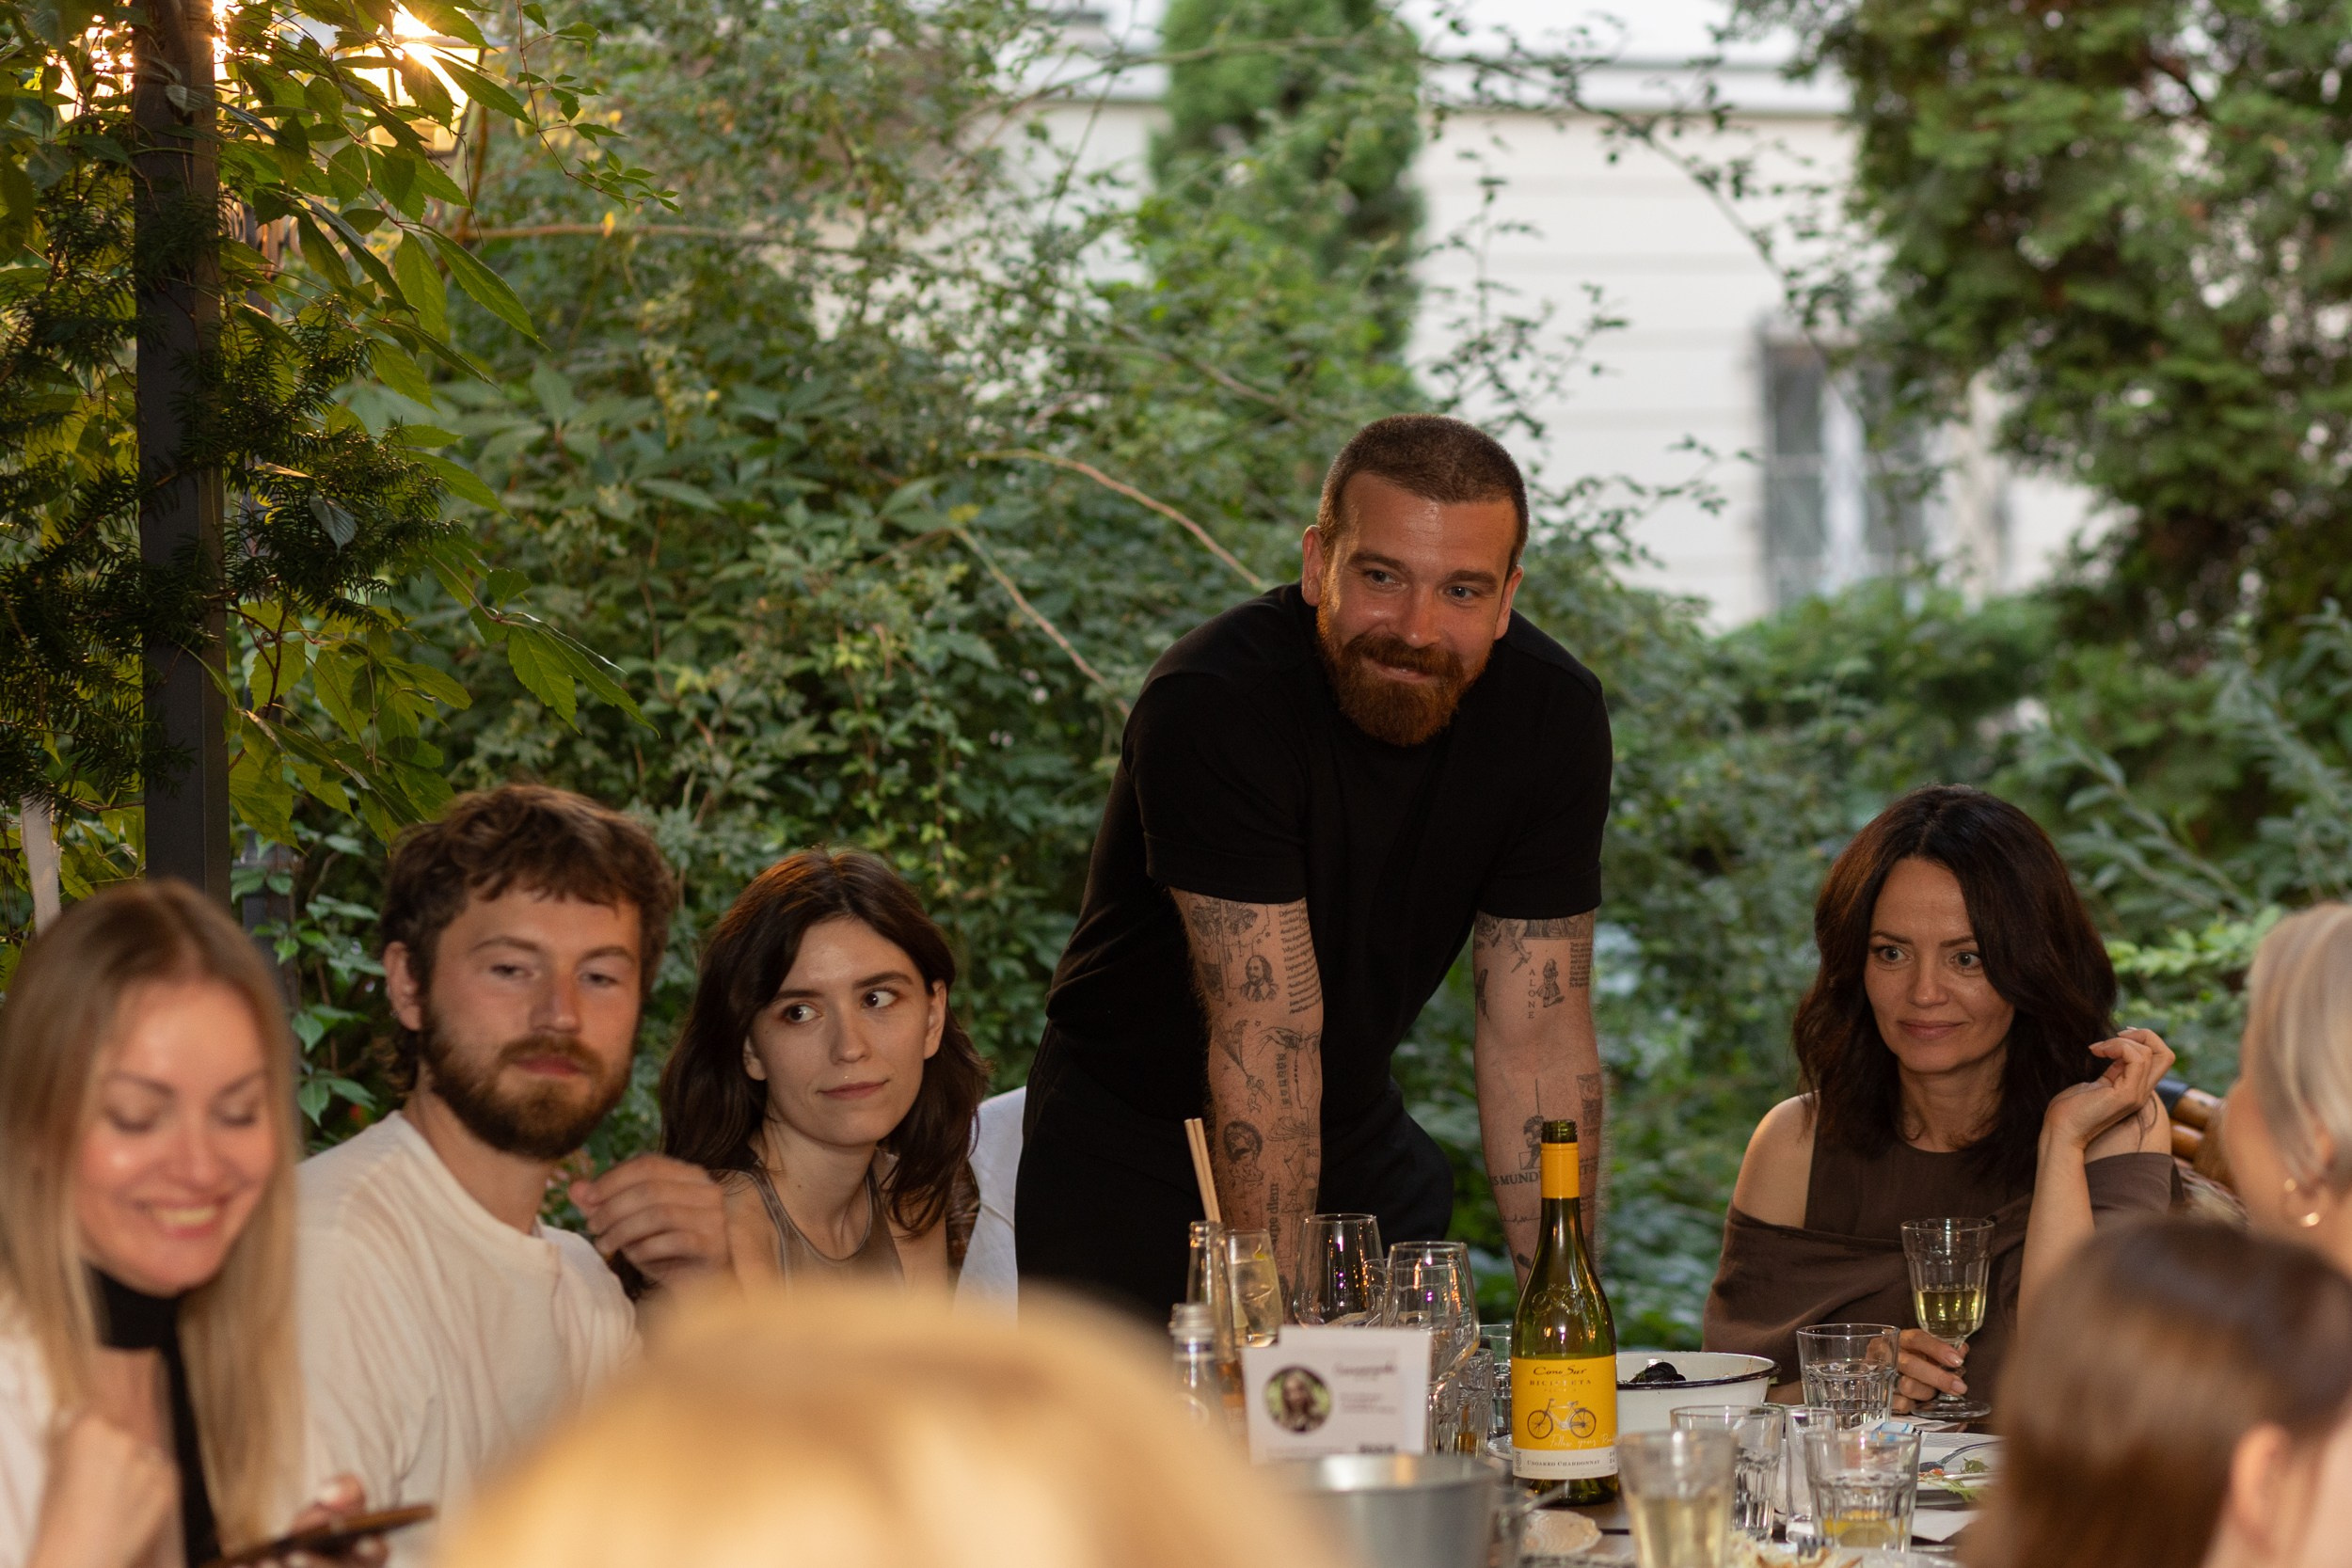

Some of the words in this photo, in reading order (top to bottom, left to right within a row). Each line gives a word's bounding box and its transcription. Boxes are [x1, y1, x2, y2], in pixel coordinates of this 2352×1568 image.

[1499, 1171, 1541, 1185] MUND
[1533, 1366, 1563, 1376] Cono
[1563, 1364, 1587, 1376] Sur
